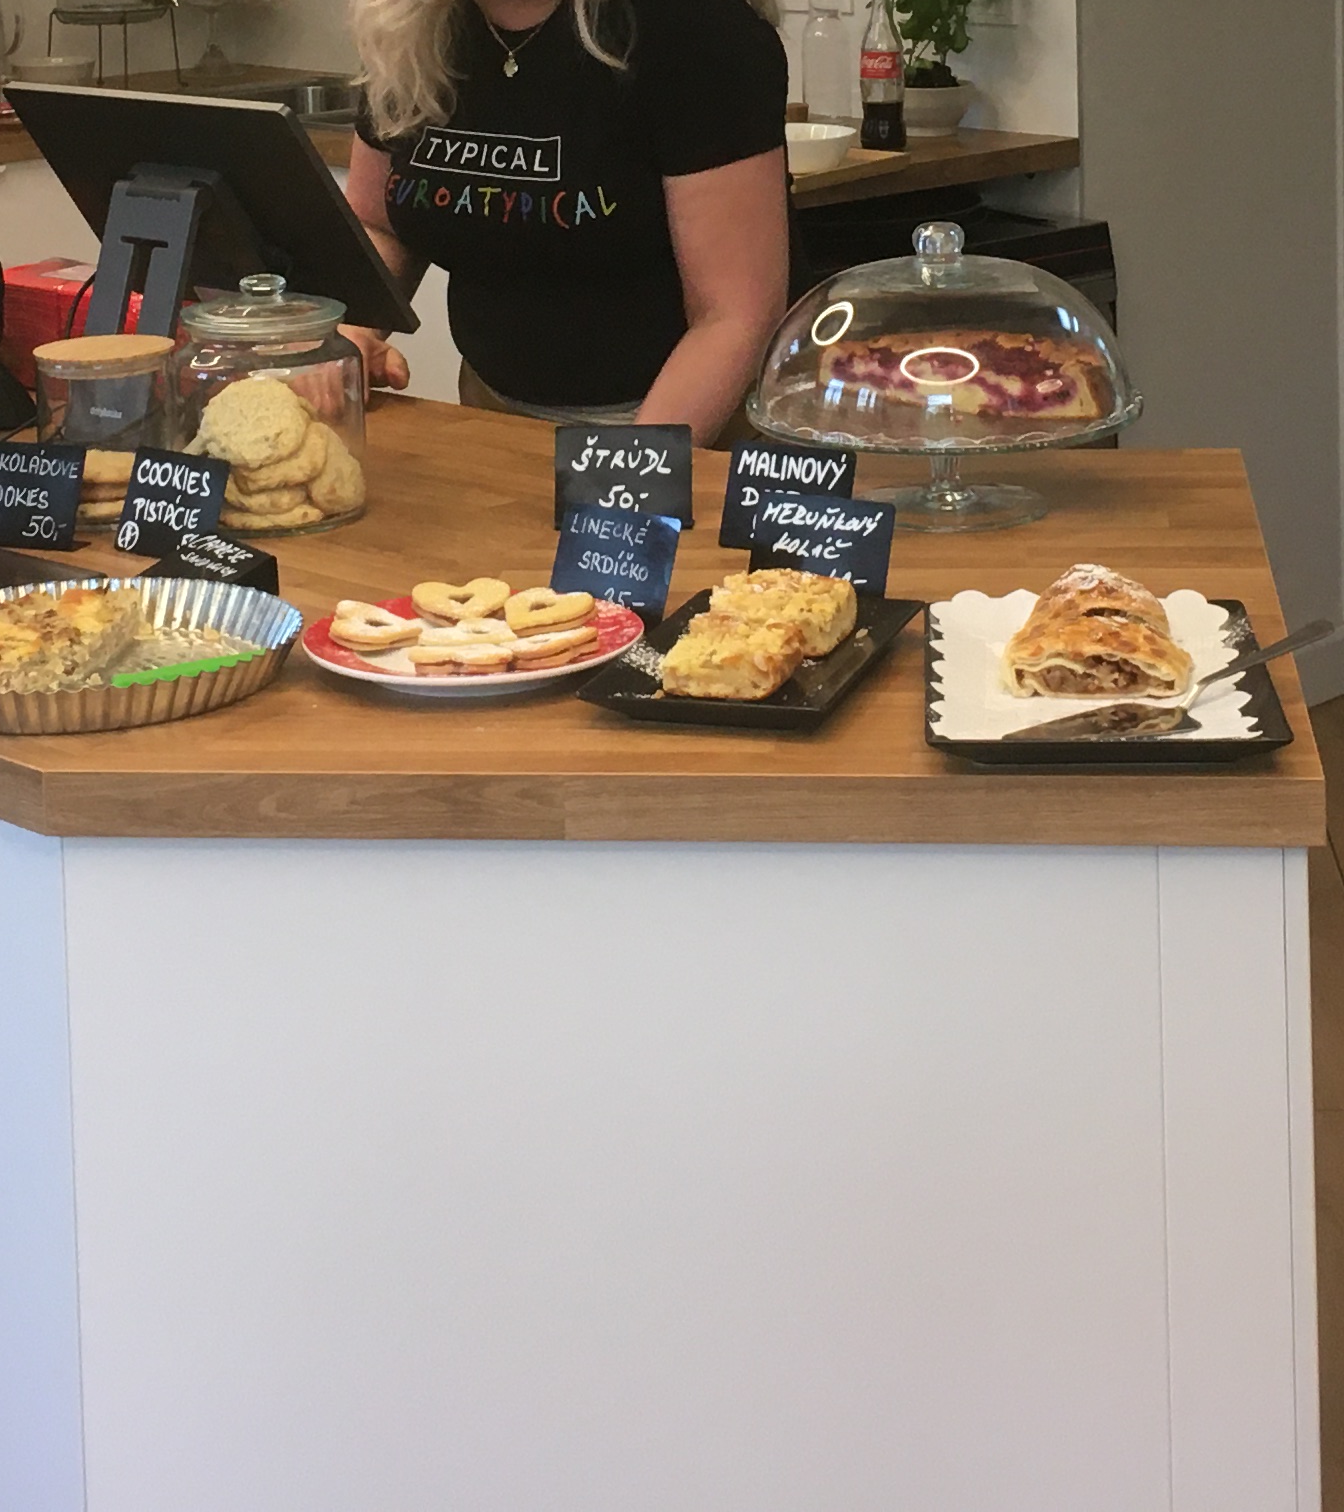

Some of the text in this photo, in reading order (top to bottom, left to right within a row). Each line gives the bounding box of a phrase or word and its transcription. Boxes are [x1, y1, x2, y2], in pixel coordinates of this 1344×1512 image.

[425, 137, 550, 172] TYPICAL
[385, 174, 617, 229] EUROATYPICAL
[136, 458, 211, 498] COOKIES
[737, 449, 847, 491] MALINOVÝ
[132, 494, 202, 532] PISTÁCIE
[569, 512, 651, 547] LINECKÉ
[577, 550, 649, 582] SRDÍČKO
